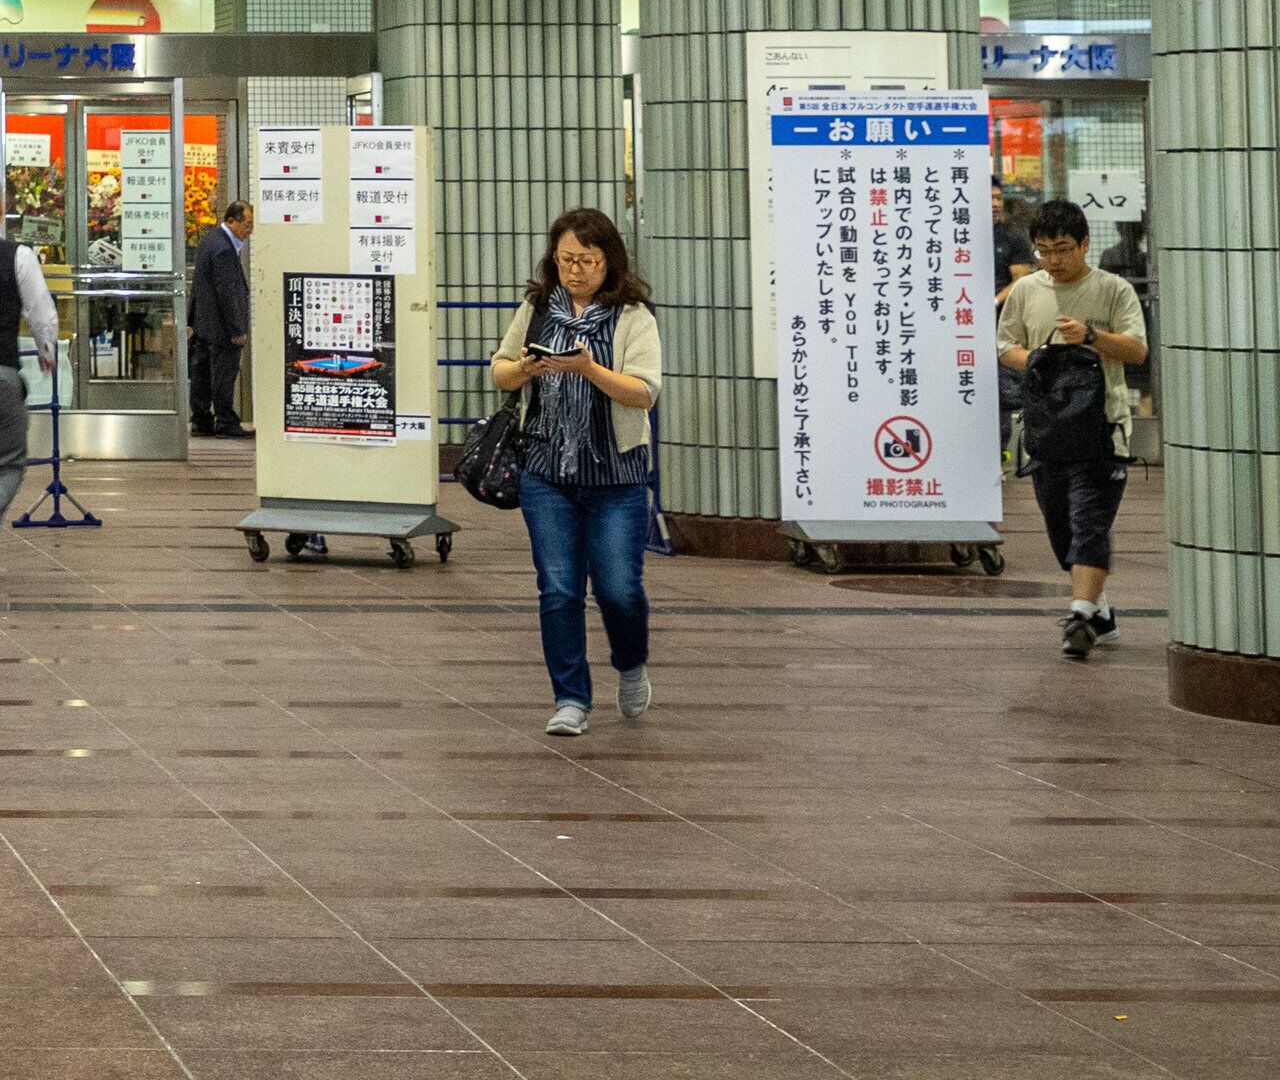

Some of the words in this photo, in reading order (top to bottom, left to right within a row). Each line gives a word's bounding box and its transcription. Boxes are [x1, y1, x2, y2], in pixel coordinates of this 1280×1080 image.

[125, 136, 166, 146] JFKO会員
[264, 140, 315, 154] 来賓受付
[352, 140, 412, 150] JFKO会員受付
[137, 148, 155, 158] 受付
[126, 176, 166, 186] 報道受付
[261, 189, 320, 201] 関係者受付
[355, 190, 408, 203] 報道受付
[1081, 192, 1126, 210] 入口
[124, 210, 168, 220] 関係者受付
[358, 234, 405, 246] 有料撮影
[924, 166, 946, 321] となっております。
[130, 242, 164, 252] 有料撮影
[138, 253, 156, 263] 受付
[371, 250, 394, 263] 受付
[814, 168, 839, 343] にアップいたします。
[868, 166, 897, 384] は禁止となっております。
[288, 278, 302, 344] 頂上決戦。
[291, 384, 388, 396] 第5回全日本フルコンタクト
[291, 394, 388, 408] 空手道選手権大会
[791, 315, 813, 505] あらかじめご了承下さい。
[867, 478, 944, 496] 撮影禁止
[879, 500, 947, 508] PHOTOGRAPHS
